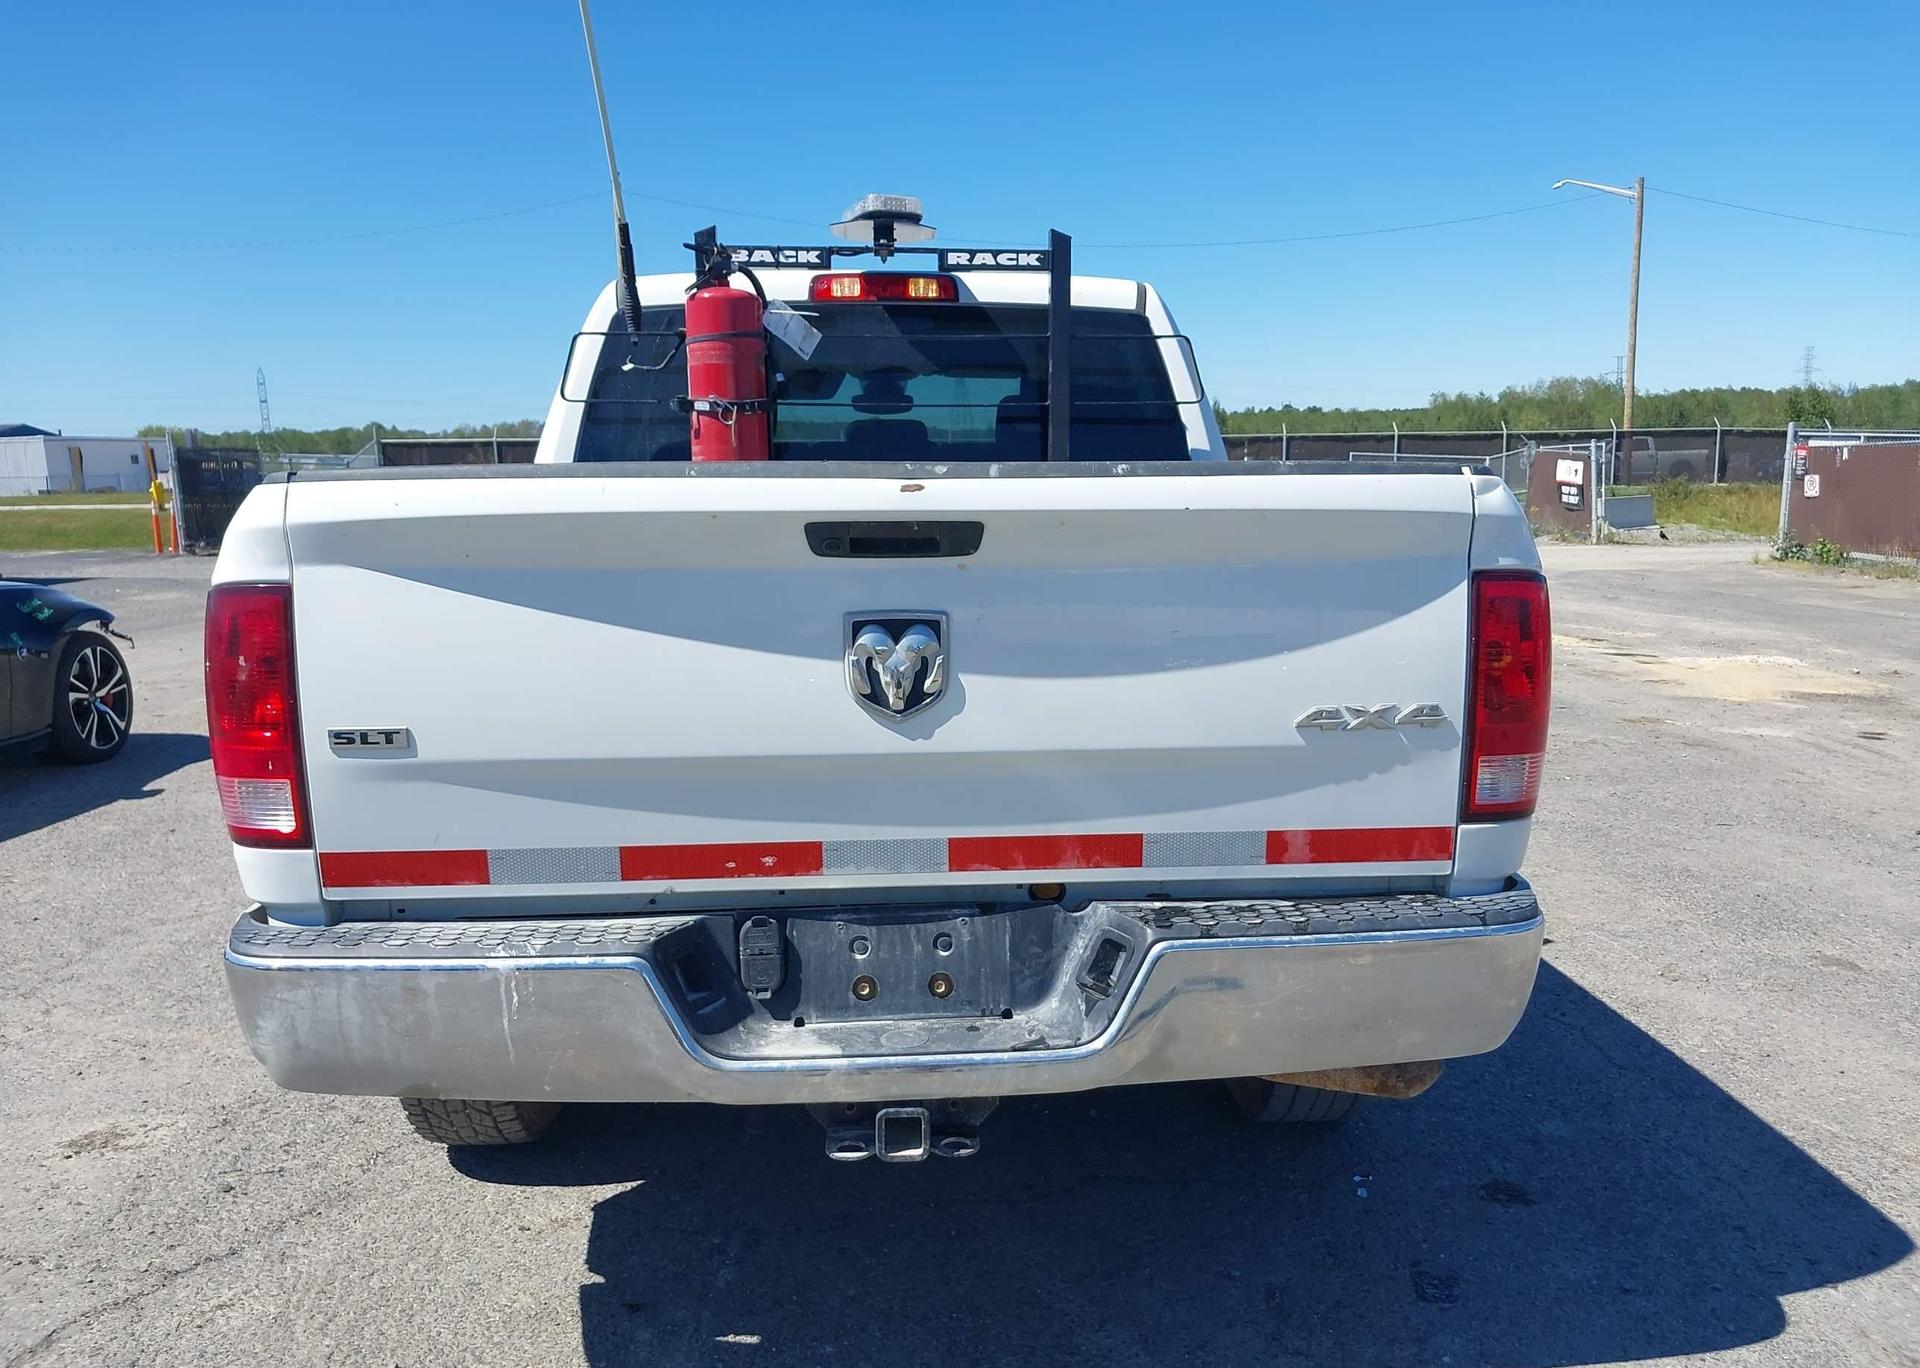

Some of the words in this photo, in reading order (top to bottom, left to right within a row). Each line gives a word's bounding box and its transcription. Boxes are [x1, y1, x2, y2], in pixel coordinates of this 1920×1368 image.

[731, 249, 821, 263] BACK
[947, 252, 1042, 266] RACK
[333, 731, 401, 745] SLT
